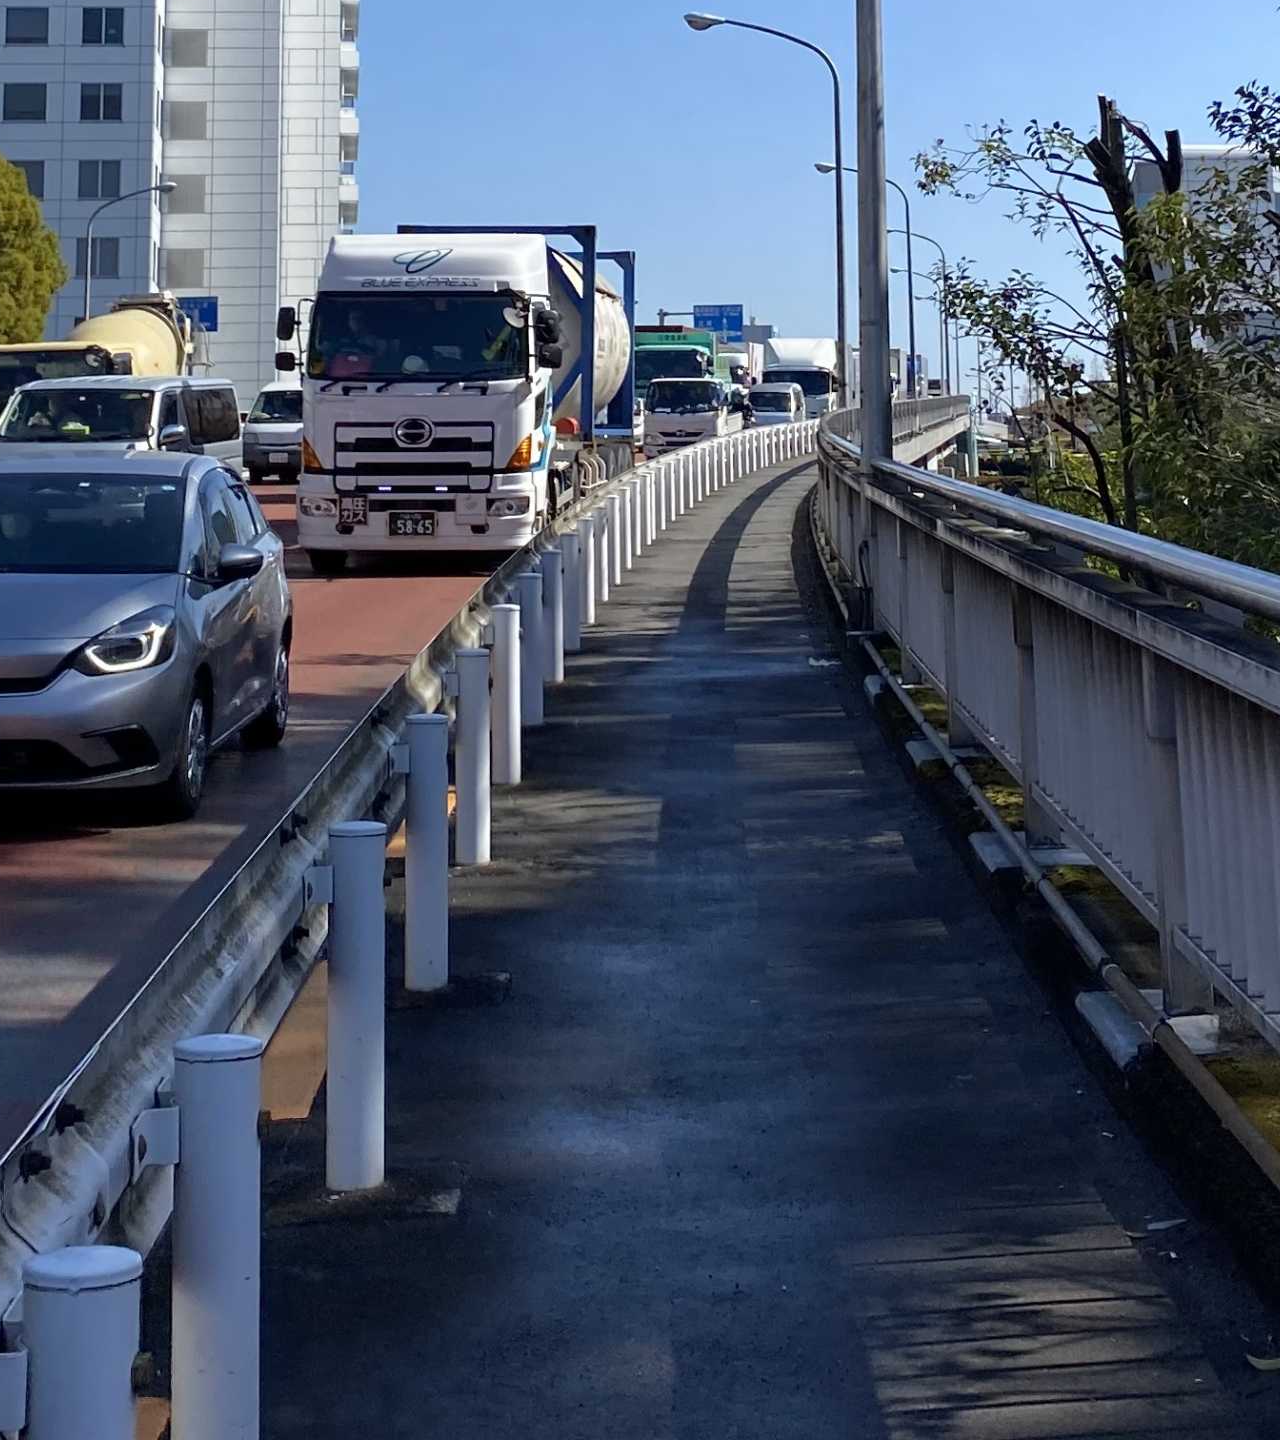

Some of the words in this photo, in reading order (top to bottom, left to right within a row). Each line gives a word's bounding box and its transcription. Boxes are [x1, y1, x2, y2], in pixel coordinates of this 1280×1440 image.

[361, 278, 401, 288] BLUE
[404, 277, 480, 288] EXPRESS
[397, 519, 433, 534] 58-65
